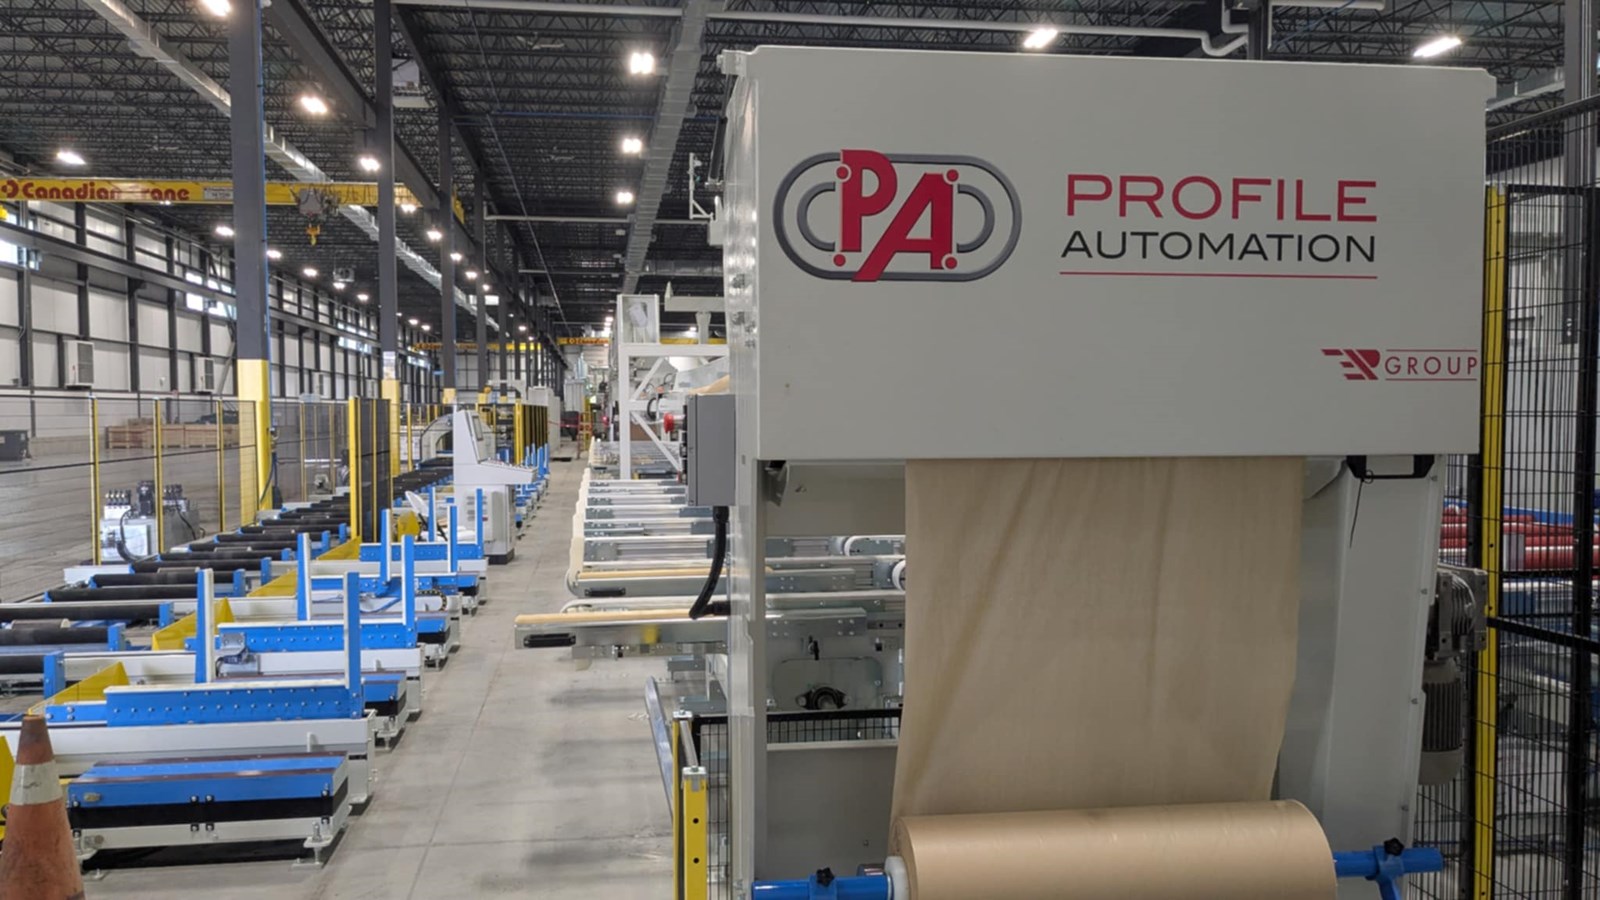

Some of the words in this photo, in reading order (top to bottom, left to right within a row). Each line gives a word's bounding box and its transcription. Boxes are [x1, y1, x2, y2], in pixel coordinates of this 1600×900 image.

[22, 181, 121, 200] Canadian
[1067, 174, 1377, 222] PROFILE
[834, 149, 958, 282] PA
[1061, 230, 1375, 262] AUTOMATION
[1384, 356, 1478, 375] GROUP
